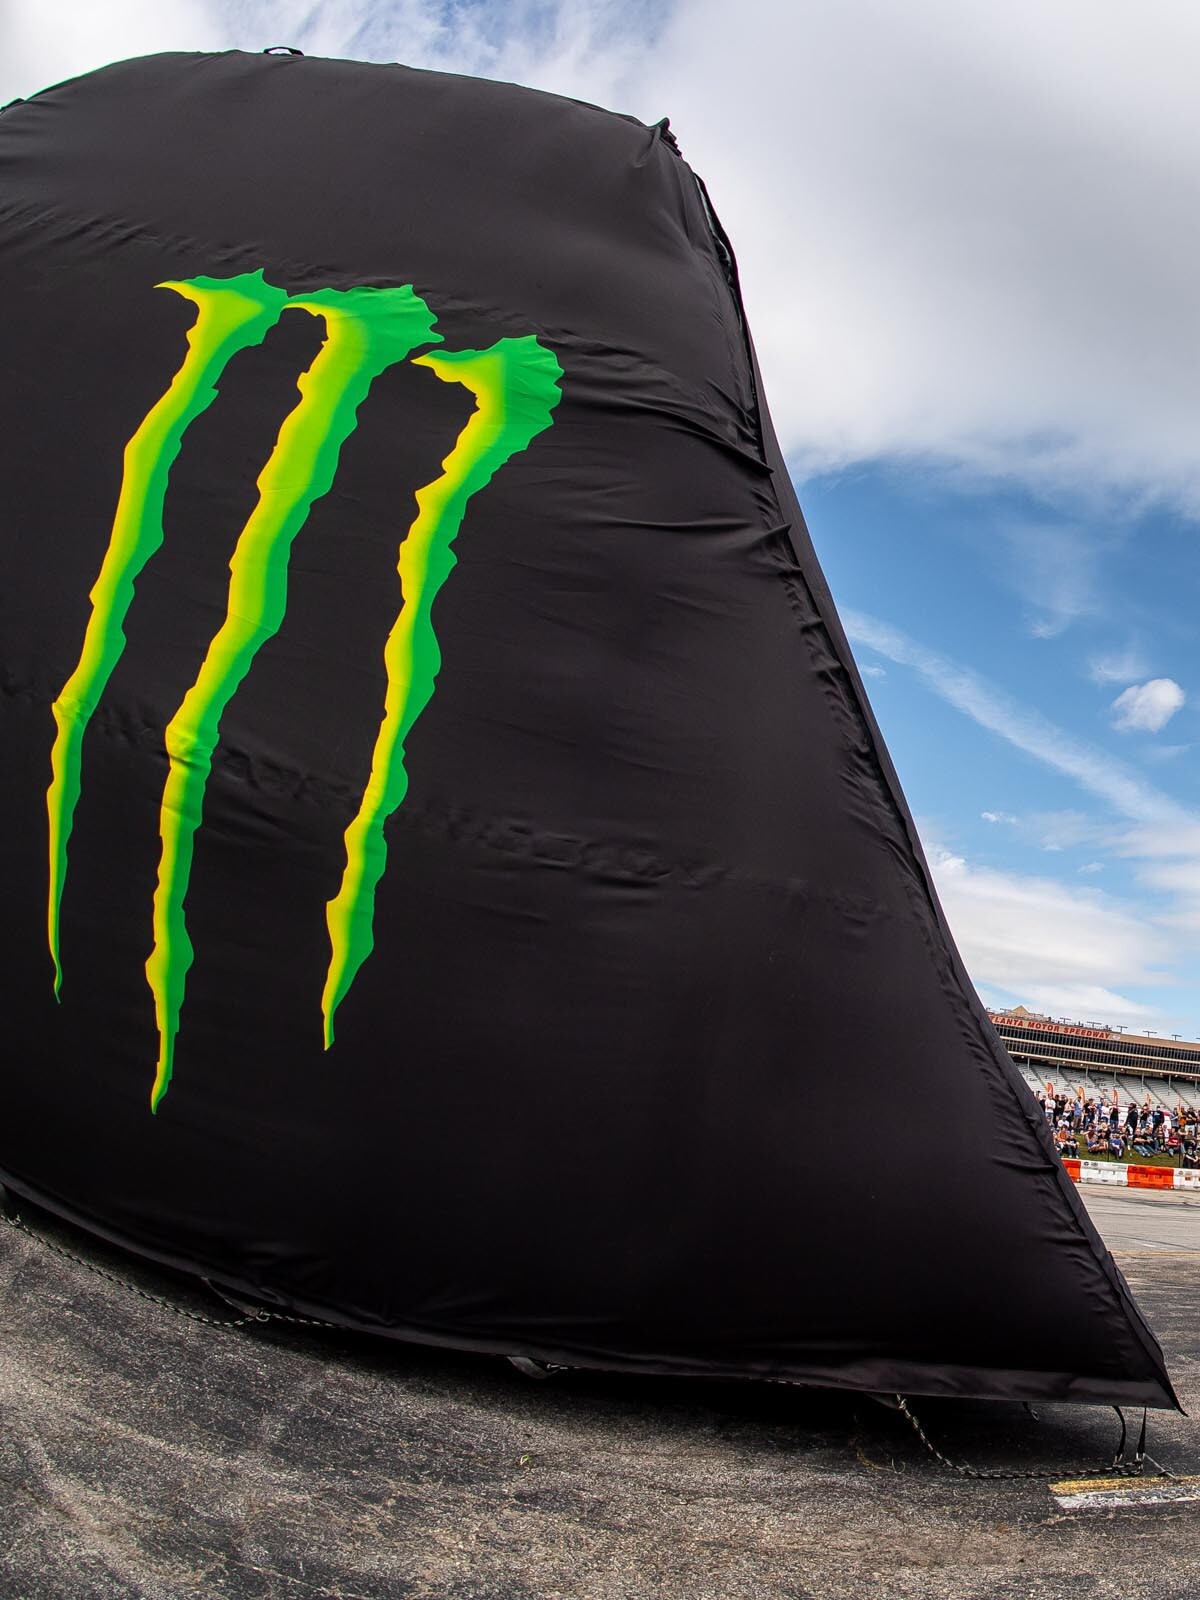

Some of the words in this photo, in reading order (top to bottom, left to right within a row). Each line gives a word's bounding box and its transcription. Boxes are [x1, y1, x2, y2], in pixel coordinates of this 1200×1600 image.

[989, 1015, 1024, 1027] TLANTA
[1027, 1021, 1060, 1032] MOTOR
[1063, 1027, 1111, 1039] SPEEDWAY
